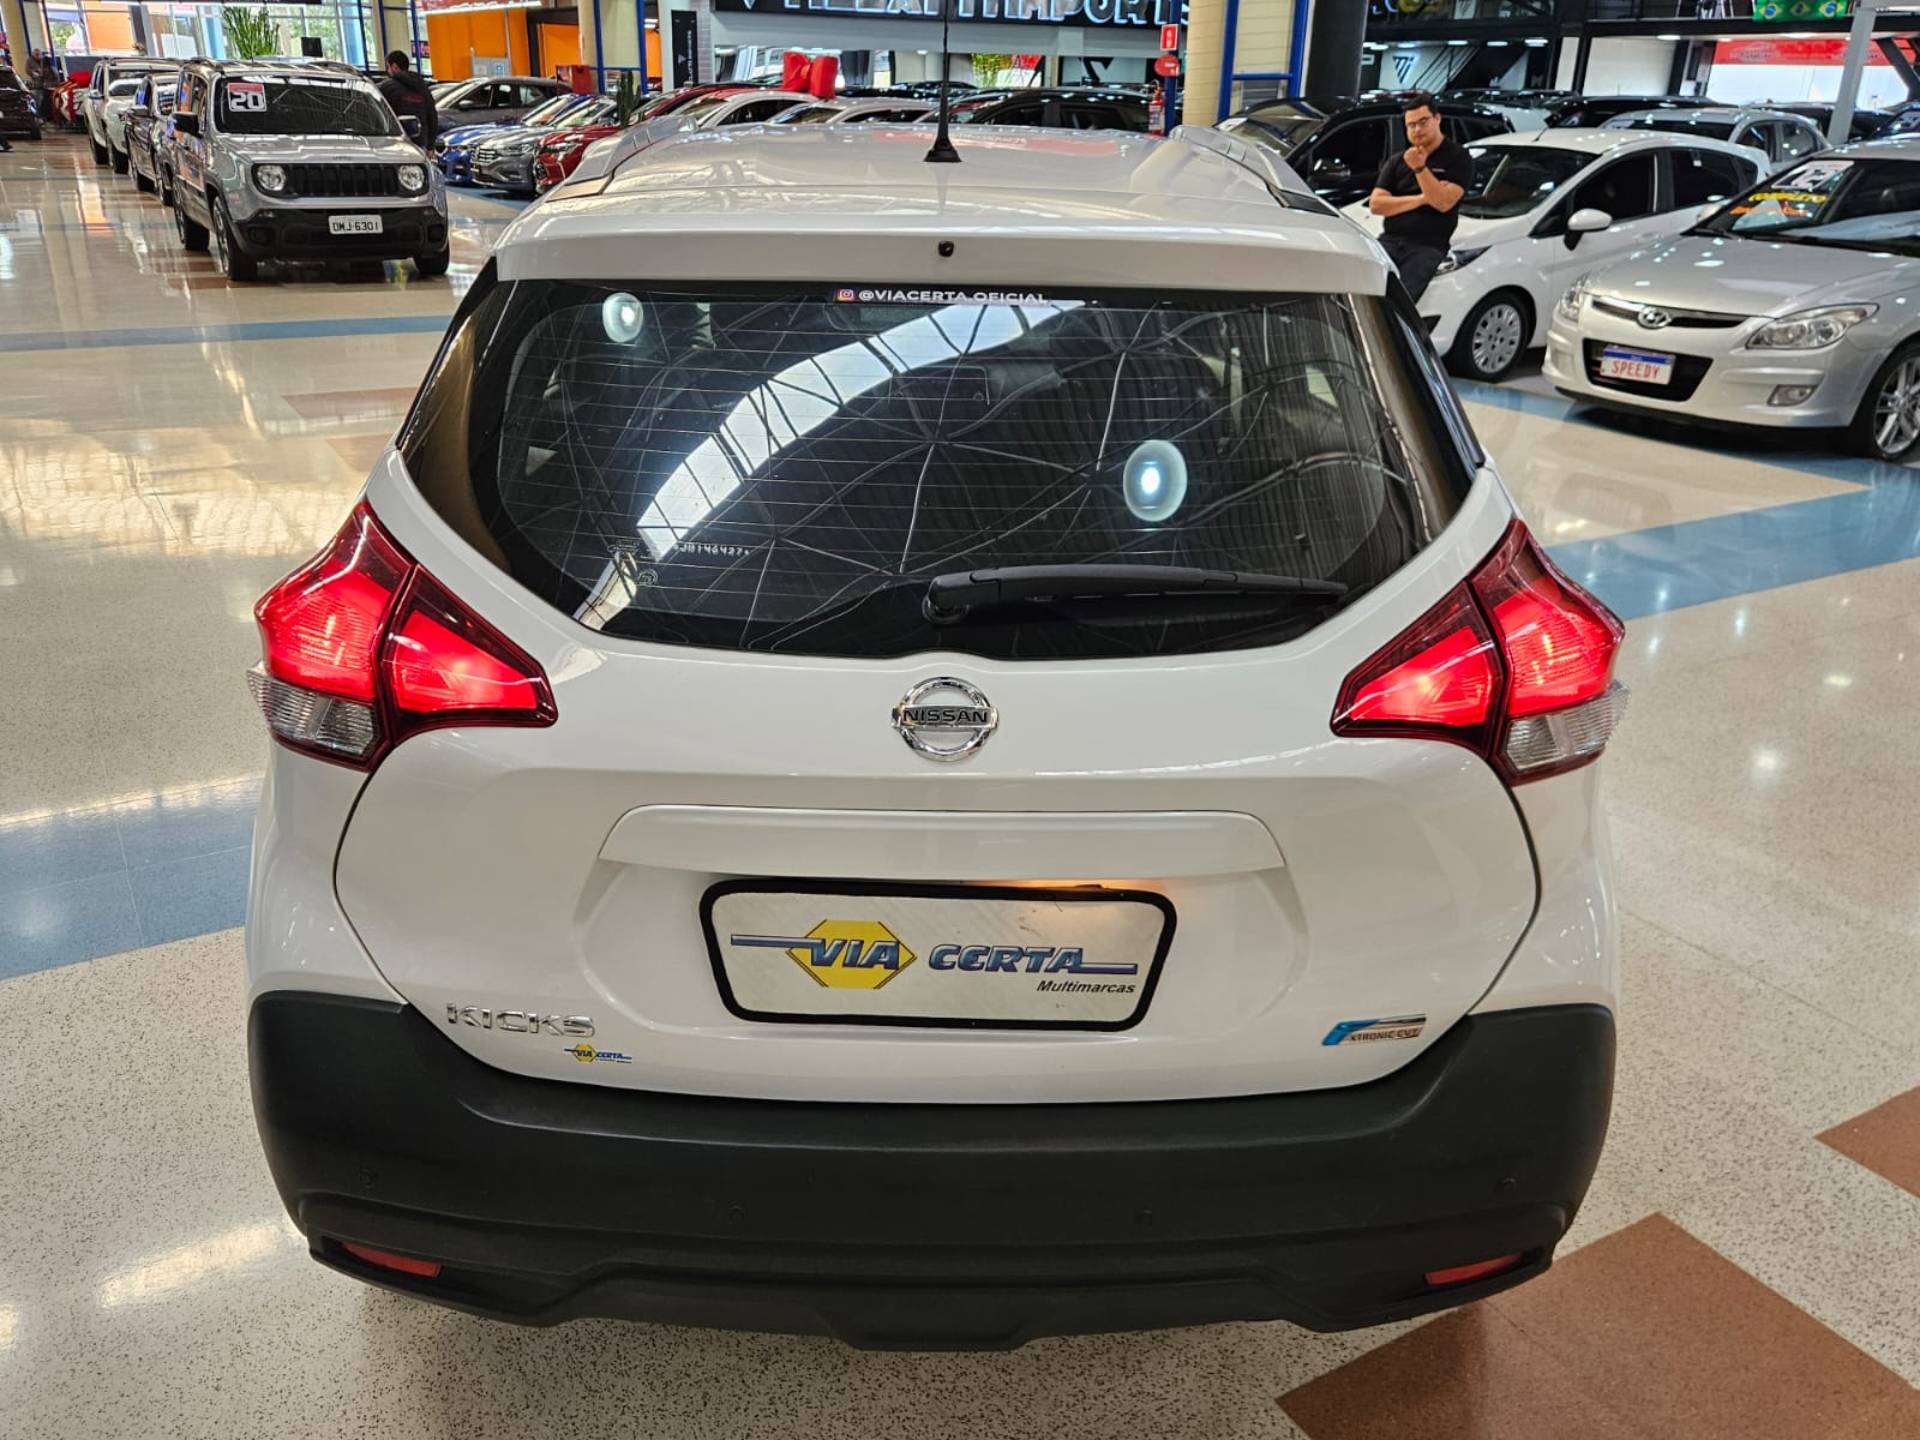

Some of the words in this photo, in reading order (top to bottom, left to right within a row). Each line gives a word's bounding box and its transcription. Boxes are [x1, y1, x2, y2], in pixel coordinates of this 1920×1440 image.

[231, 92, 265, 110] 20
[1612, 360, 1661, 379] SPEEDY
[903, 710, 988, 722] NISSAN
[811, 938, 900, 971] VIA
[928, 944, 1085, 973] CERTA
[1036, 980, 1136, 995] Multimarcas
[447, 1003, 595, 1038] KICKS
